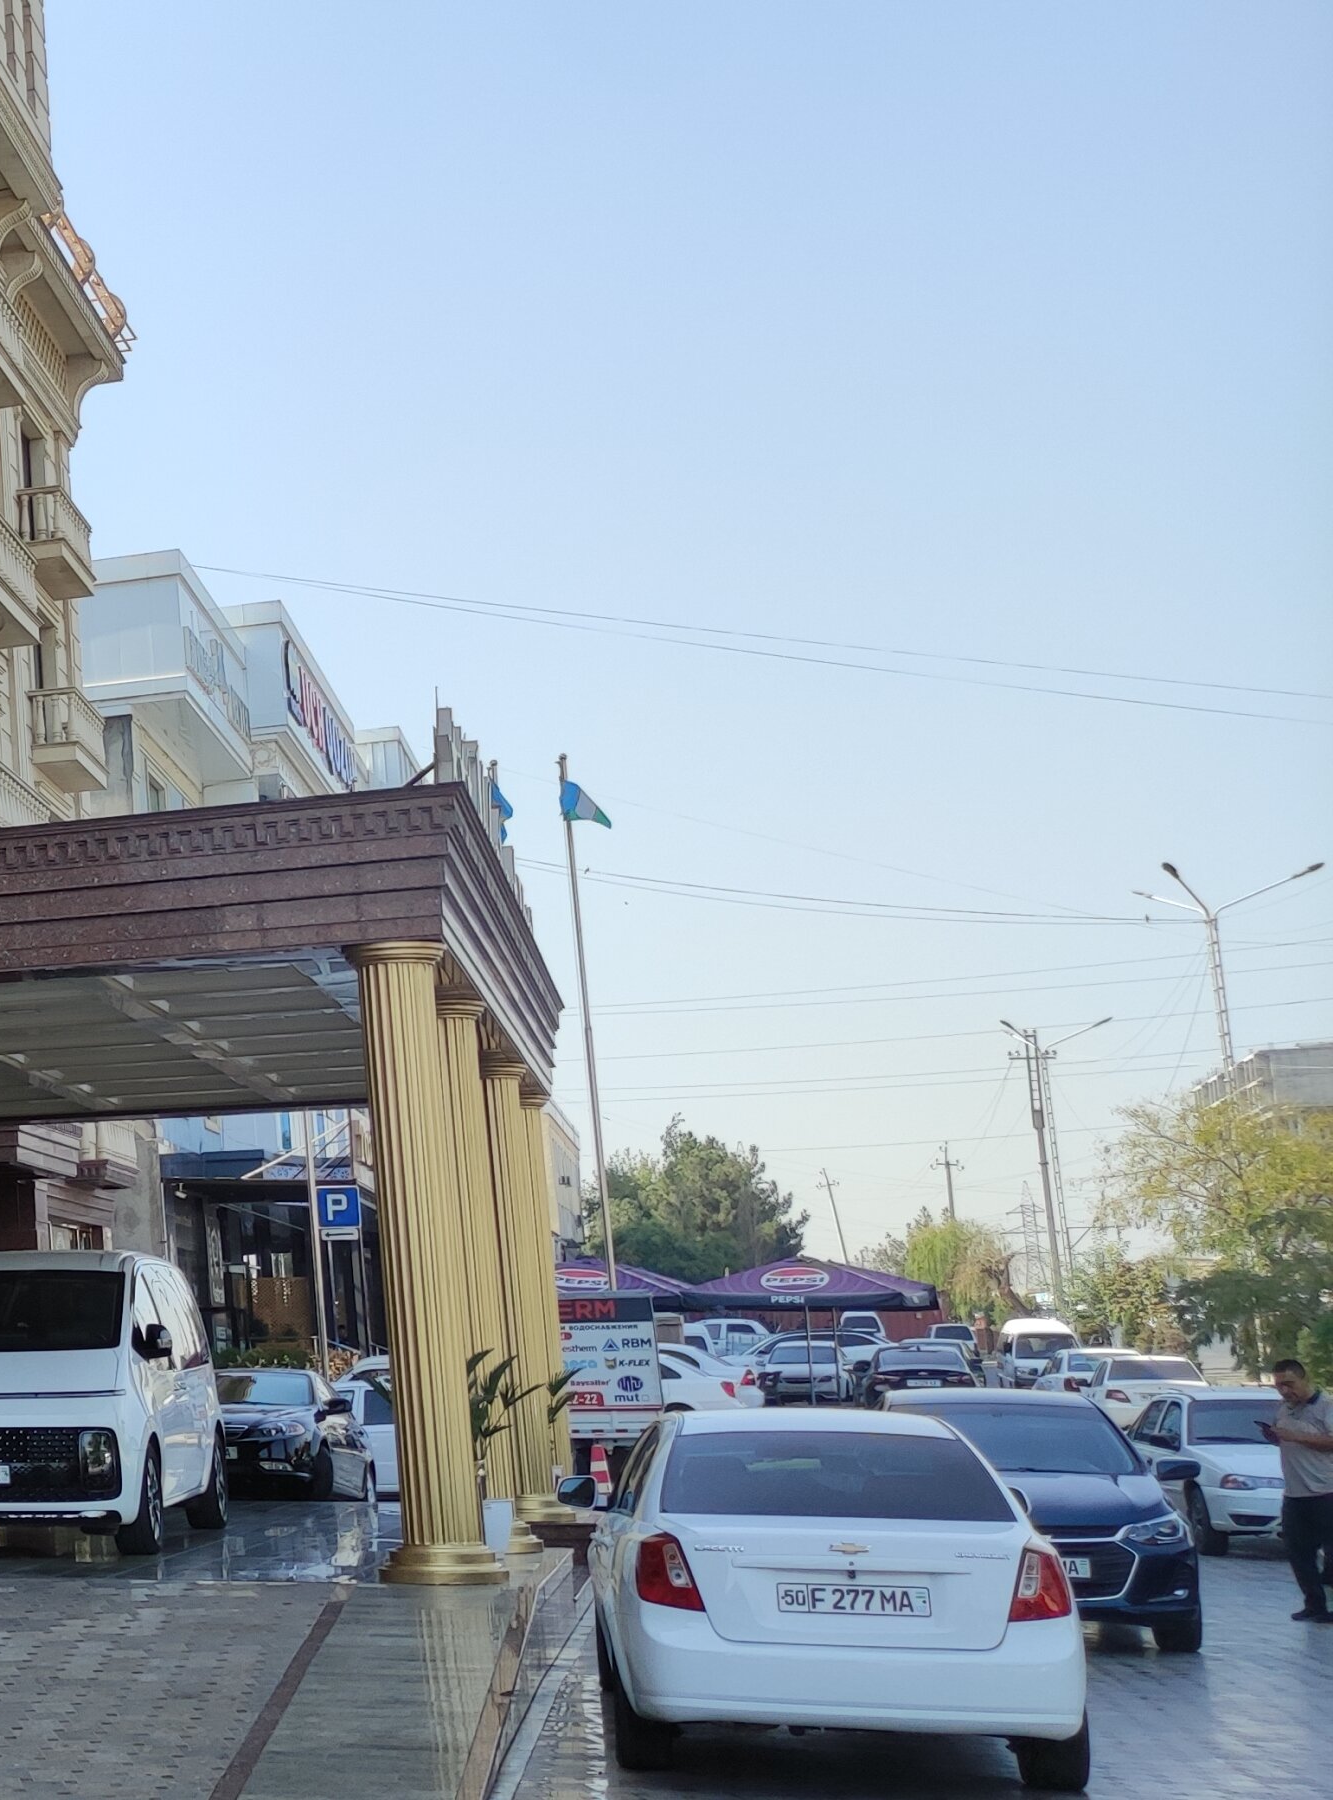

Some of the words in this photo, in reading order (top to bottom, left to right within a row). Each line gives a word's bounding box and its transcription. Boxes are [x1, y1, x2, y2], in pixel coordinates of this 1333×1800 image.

[326, 1193, 348, 1221] P
[770, 1295, 805, 1304] PEPSI
[621, 1338, 652, 1348] RBM
[618, 1359, 650, 1367] K-FLEX
[784, 1589, 807, 1606] 50
[810, 1588, 827, 1609] F
[832, 1588, 875, 1611] 277
[879, 1590, 915, 1613] MA
